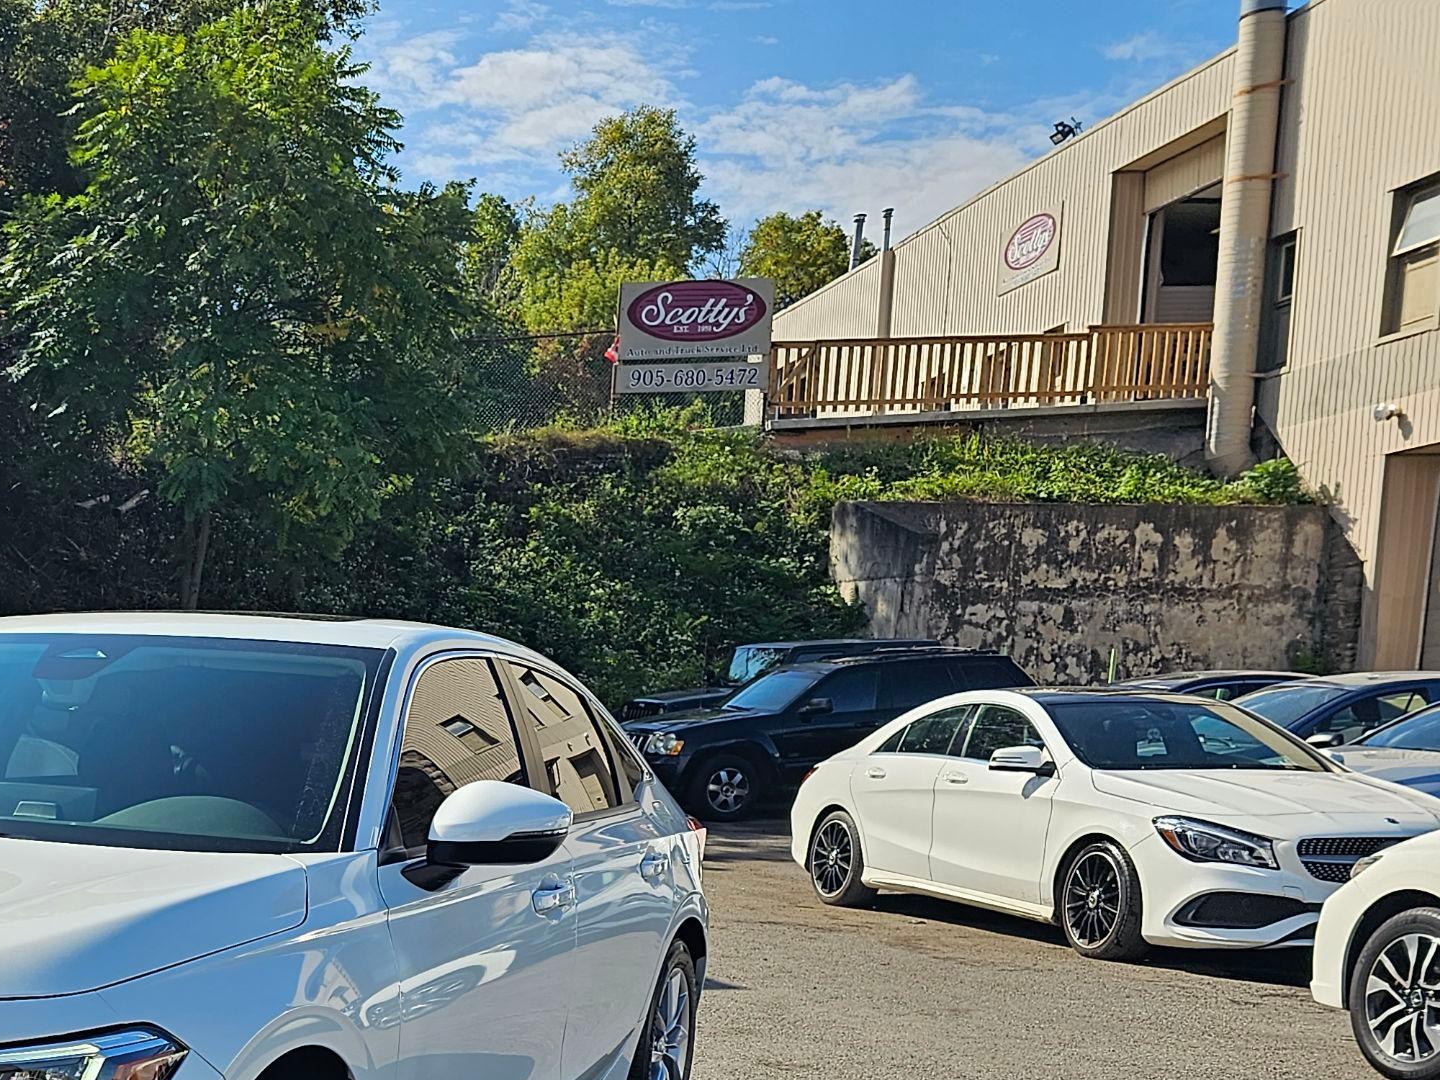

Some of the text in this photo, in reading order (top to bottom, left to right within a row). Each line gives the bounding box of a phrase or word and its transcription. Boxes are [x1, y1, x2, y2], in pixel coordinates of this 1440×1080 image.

[641, 292, 753, 333] Scotty's
[627, 348, 649, 356] Auto
[654, 347, 671, 355] and
[675, 345, 702, 354] Truck
[704, 345, 738, 353] Service
[630, 368, 758, 387] 905-680-5472
